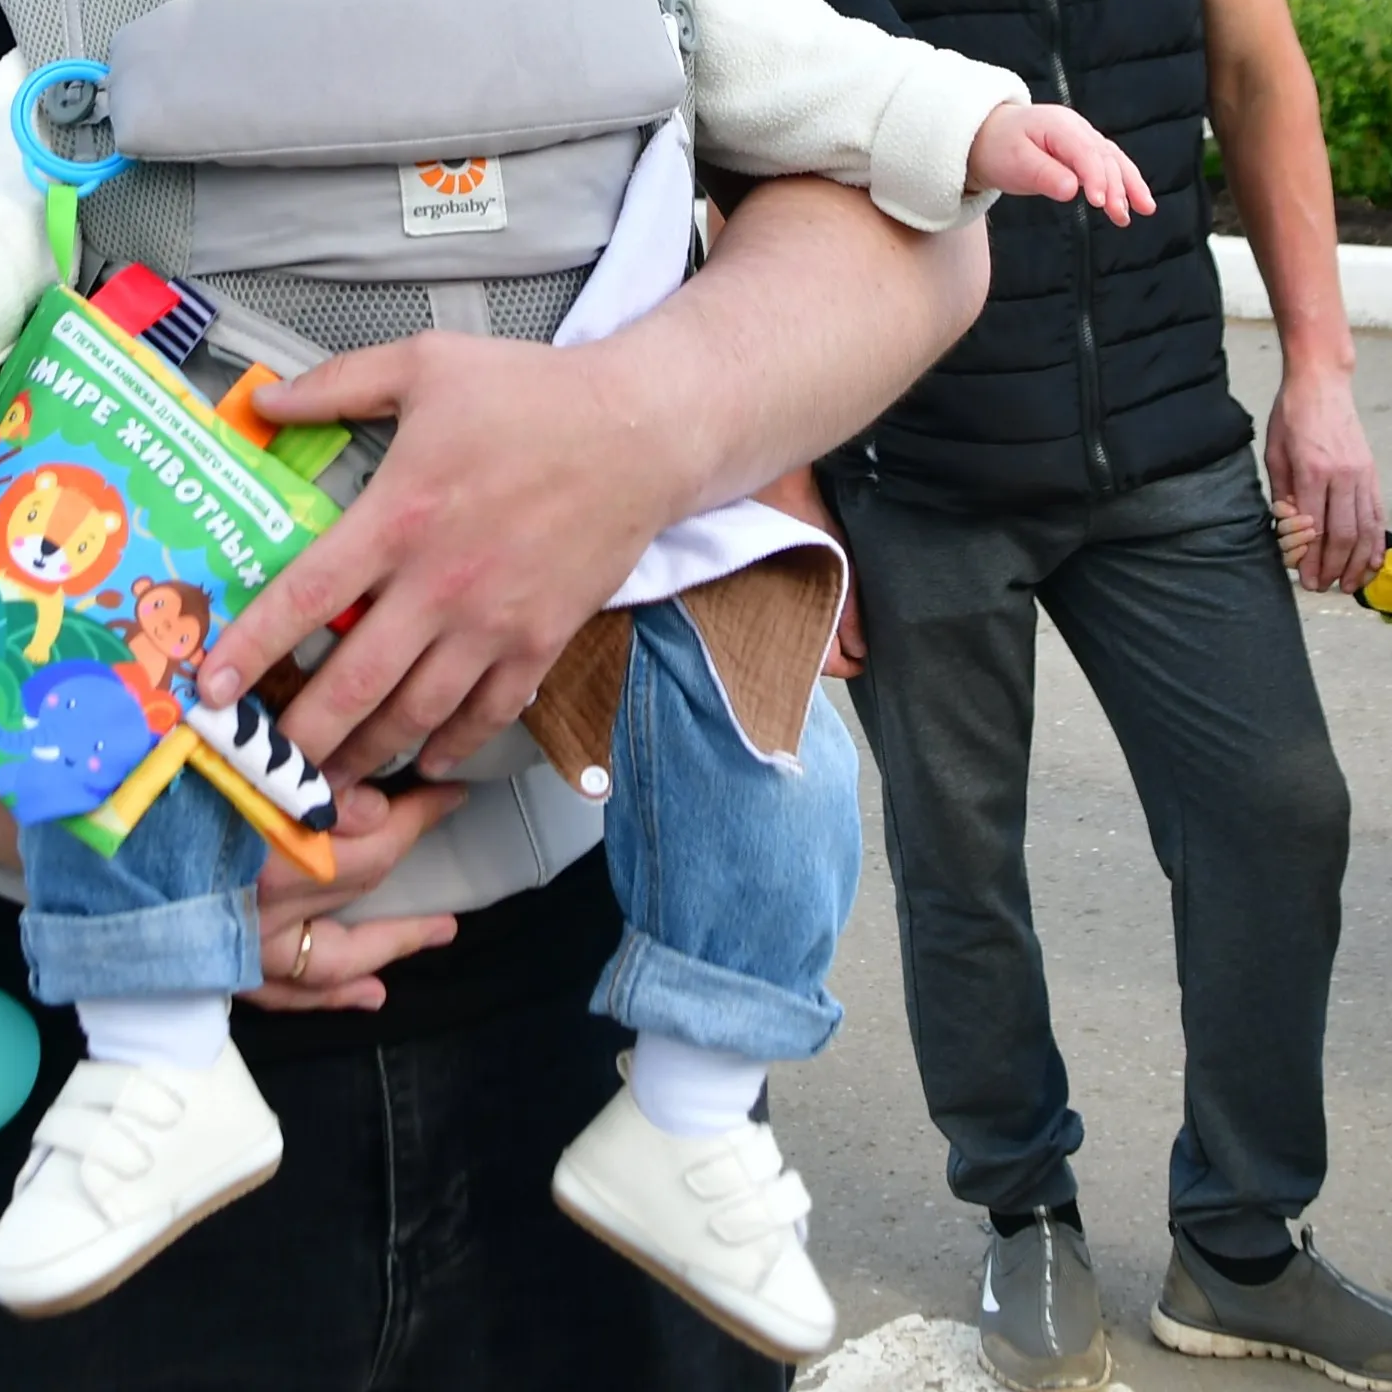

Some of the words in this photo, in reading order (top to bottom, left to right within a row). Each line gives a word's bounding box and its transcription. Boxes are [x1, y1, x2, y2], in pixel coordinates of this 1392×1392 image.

[30, 355, 121, 427] МИРЕ
[116, 417, 267, 590] ЖИВОТНЫХ
[72, 328, 113, 369] ПЕРВАЯ
[111, 364, 158, 409] КНИЖКА
[154, 405, 183, 434] ДЛЯ
[180, 427, 223, 471] ВАШЕГО
[220, 468, 272, 519] МАЛЫША
